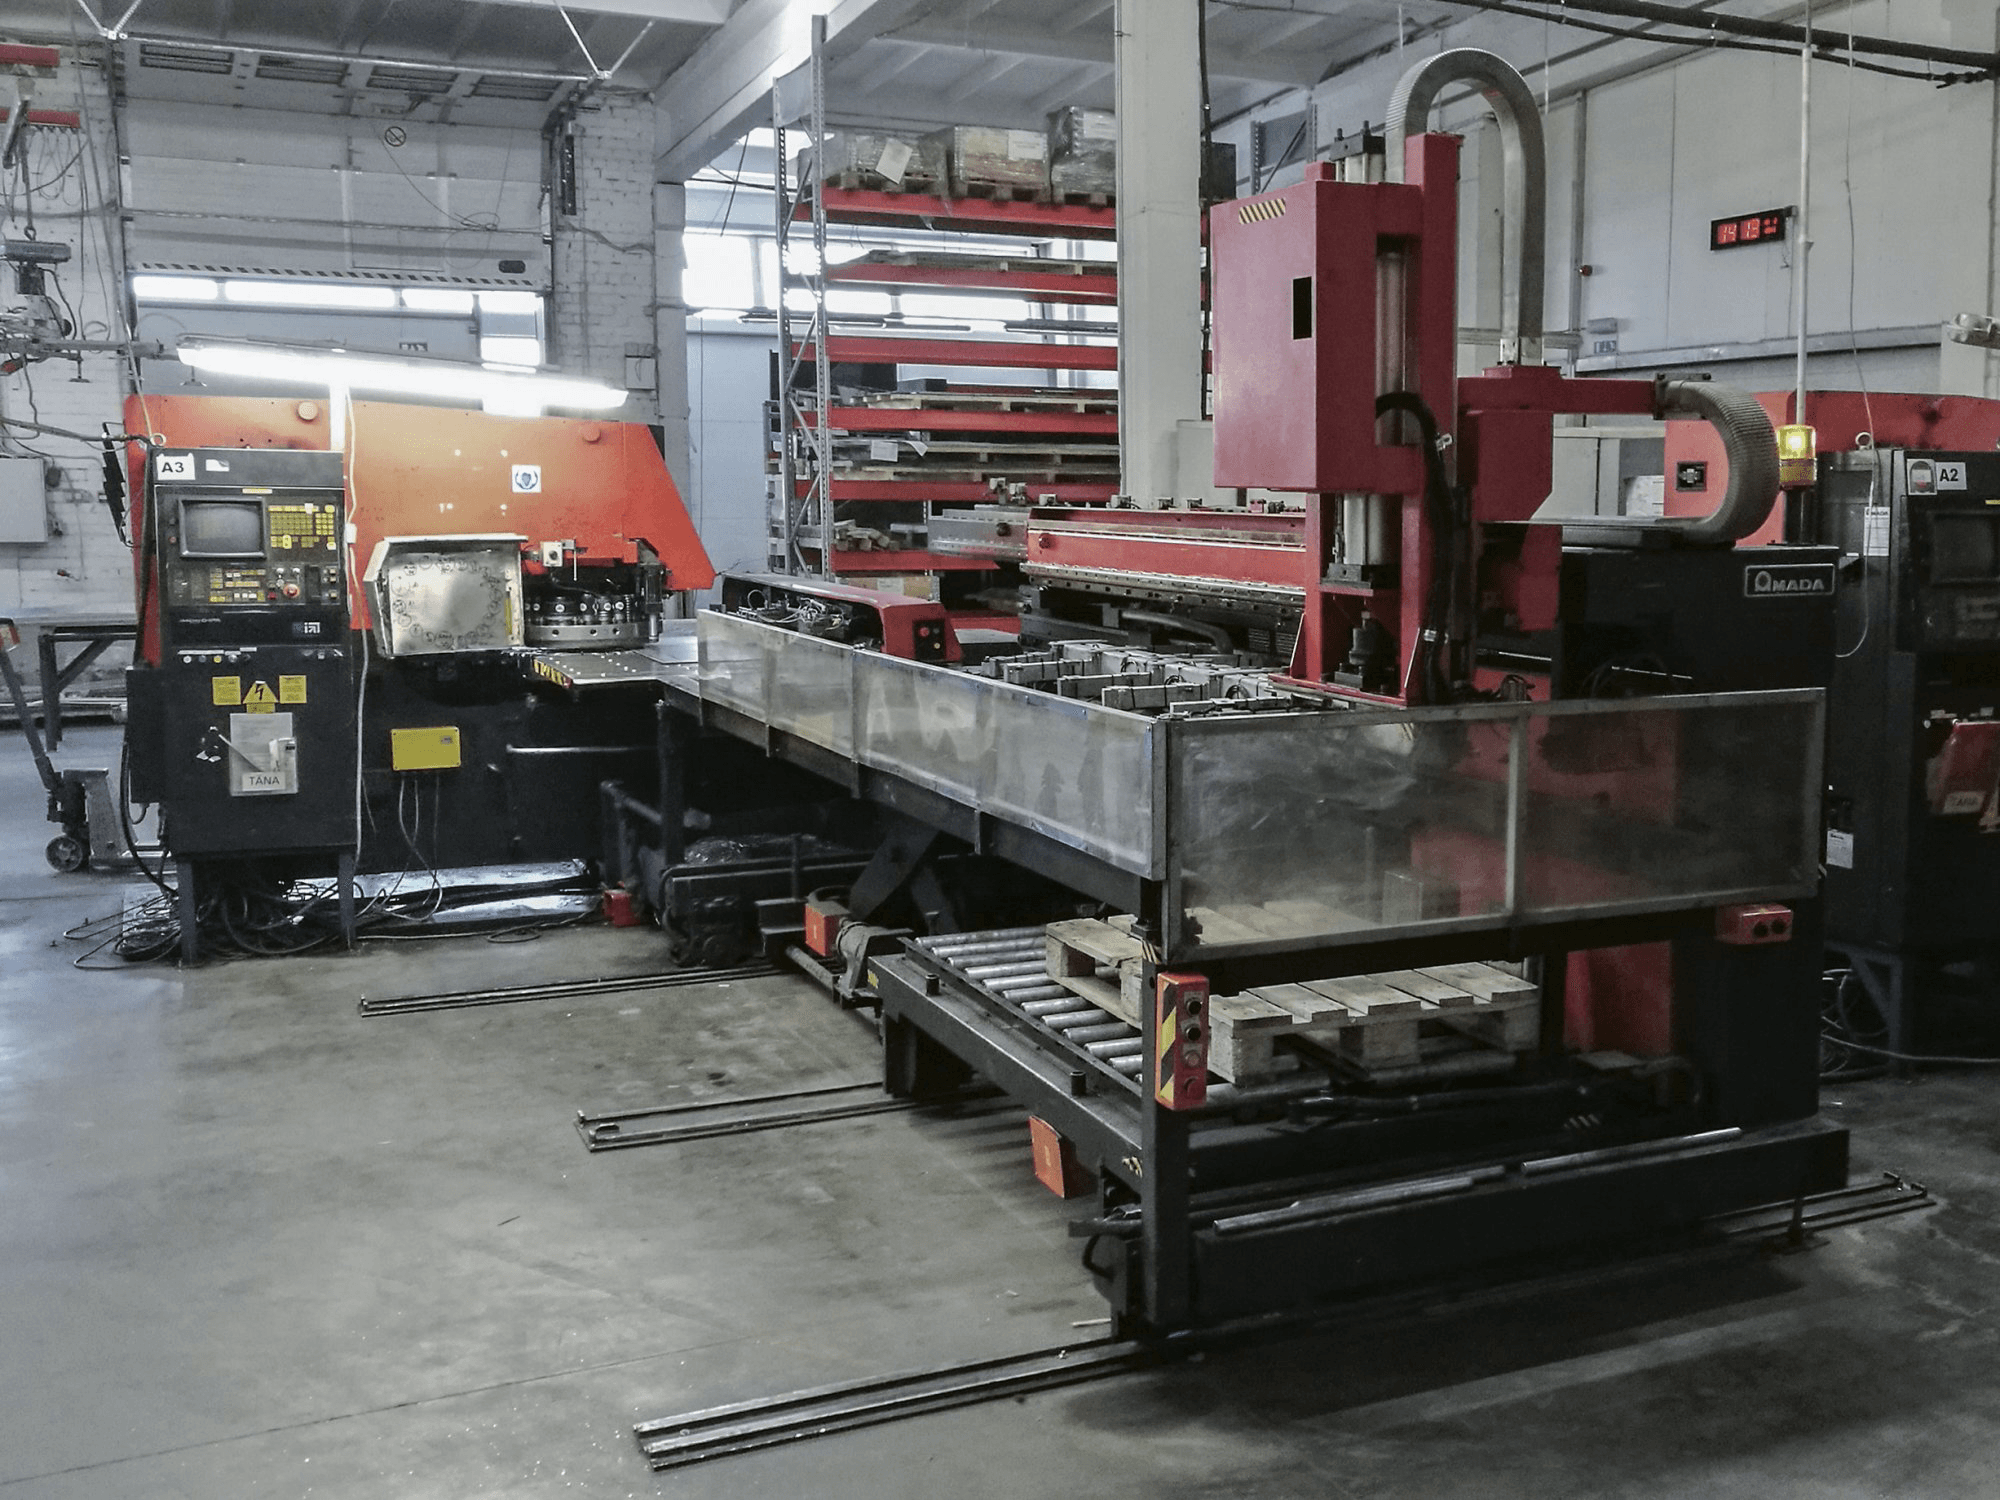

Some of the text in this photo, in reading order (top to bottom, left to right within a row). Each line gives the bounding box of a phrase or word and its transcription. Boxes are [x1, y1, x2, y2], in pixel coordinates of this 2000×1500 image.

[161, 461, 185, 473] A3
[1939, 467, 1959, 482] A2
[1753, 570, 1825, 593] AMADA
[248, 775, 281, 786] TANA
